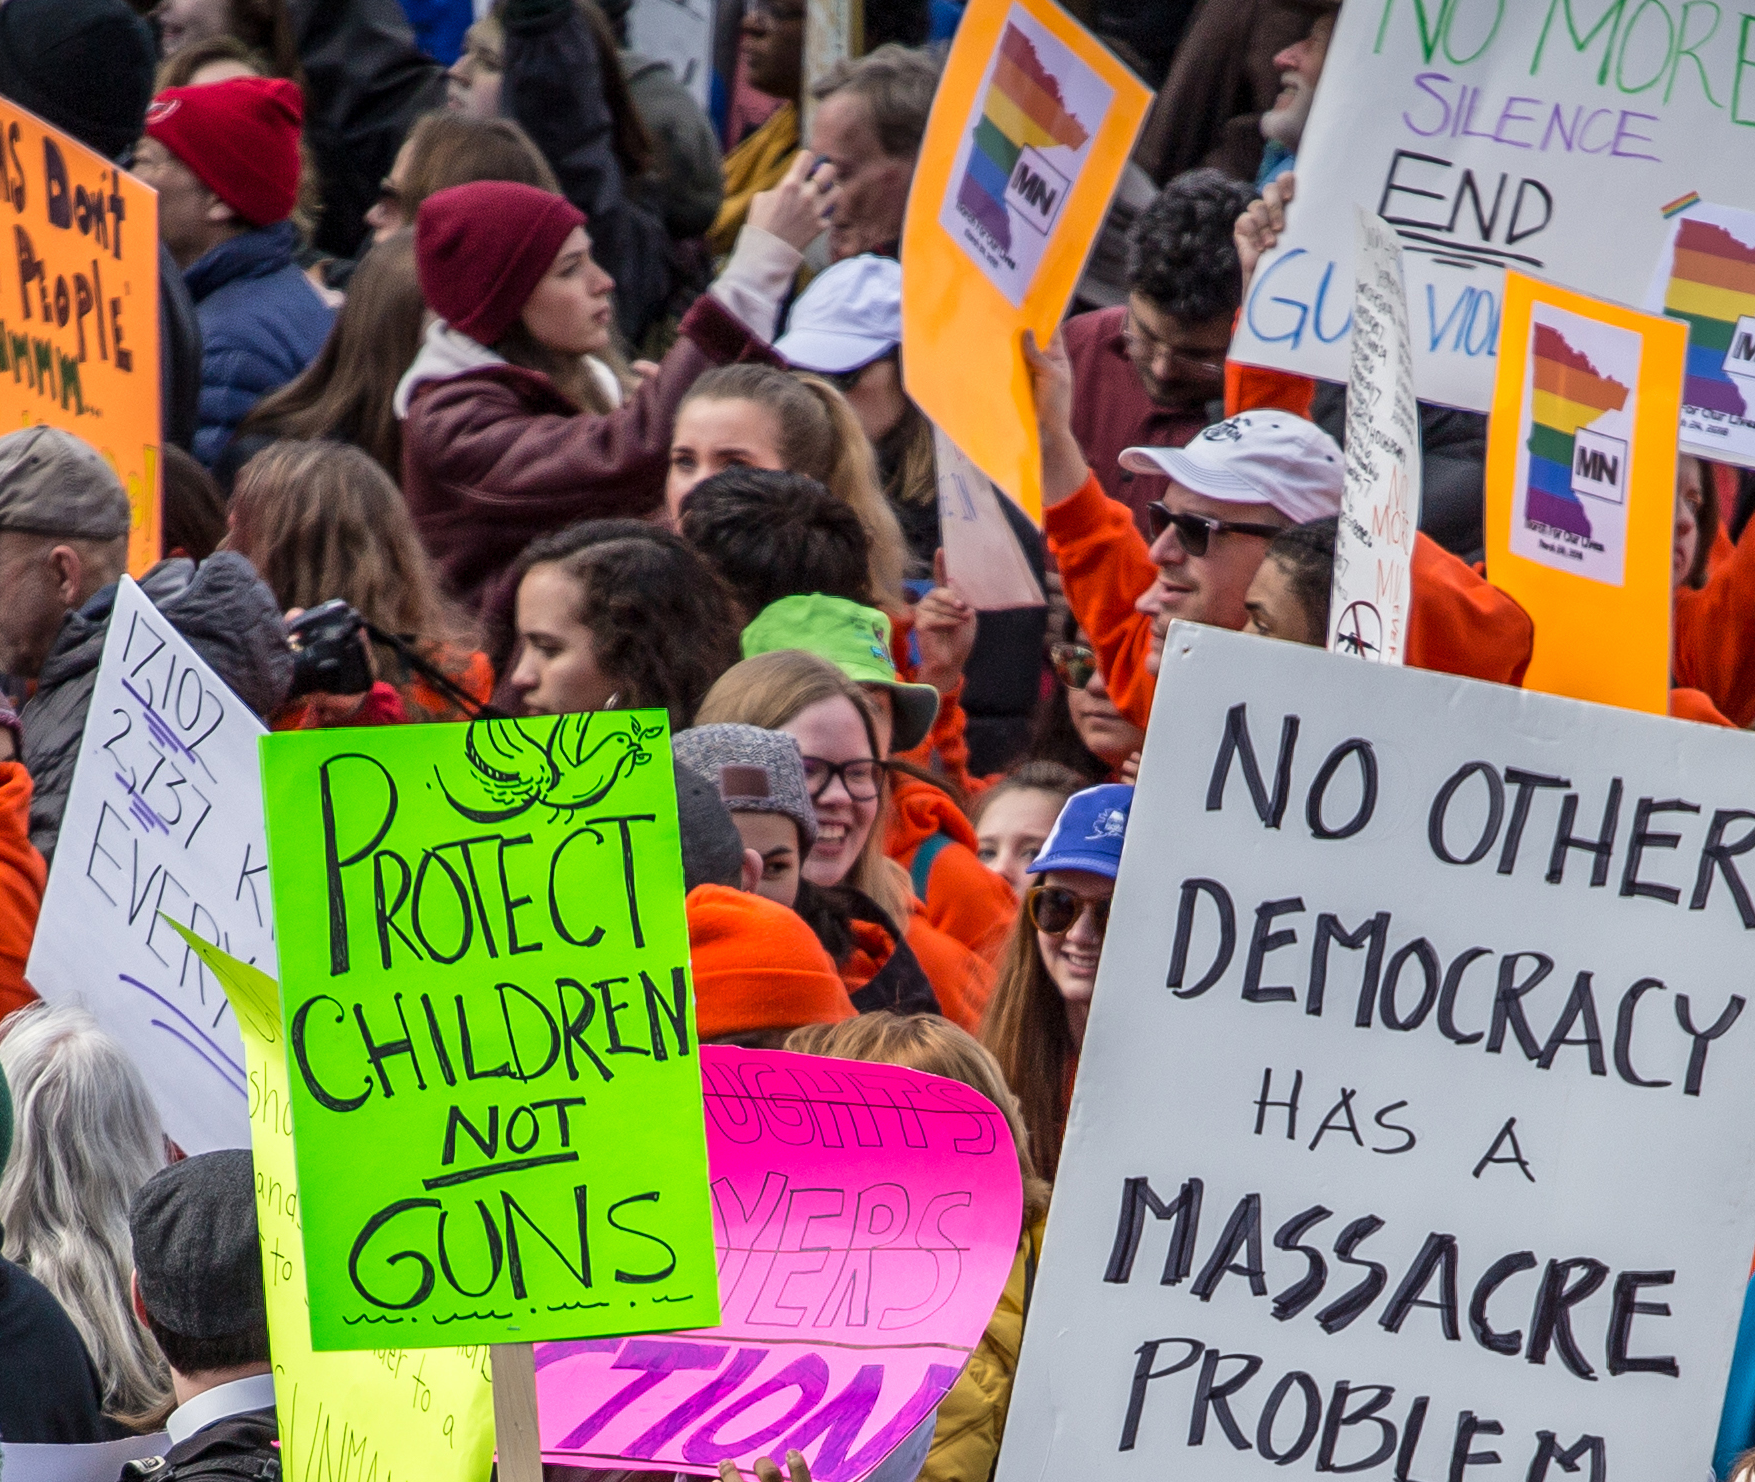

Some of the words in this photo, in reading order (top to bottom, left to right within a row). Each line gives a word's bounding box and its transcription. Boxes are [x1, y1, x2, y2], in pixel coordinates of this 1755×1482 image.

[1375, 0, 1501, 65] NO
[1403, 72, 1662, 162] SILENCE
[1010, 161, 1057, 217] MN
[1379, 148, 1554, 245] END
[1247, 248, 1353, 350] GU
[1575, 445, 1619, 486] MN
[122, 610, 224, 784] 17,102
[103, 708, 212, 849] 2,737
[1205, 703, 1379, 840] NO
[320, 753, 656, 976] PROTECT
[292, 967, 691, 1111] CHILDREN
[1165, 876, 1747, 1097] DEMOCRACY
[441, 1097, 585, 1166] NOT
[702, 1063, 996, 1154] UGHTS
[1253, 1067, 1416, 1156] HAS
[1472, 1115, 1536, 1183] A
[348, 1184, 676, 1310] GUNS
[711, 1172, 972, 1330] YERS
[1102, 1175, 1680, 1381] MASSACRE
